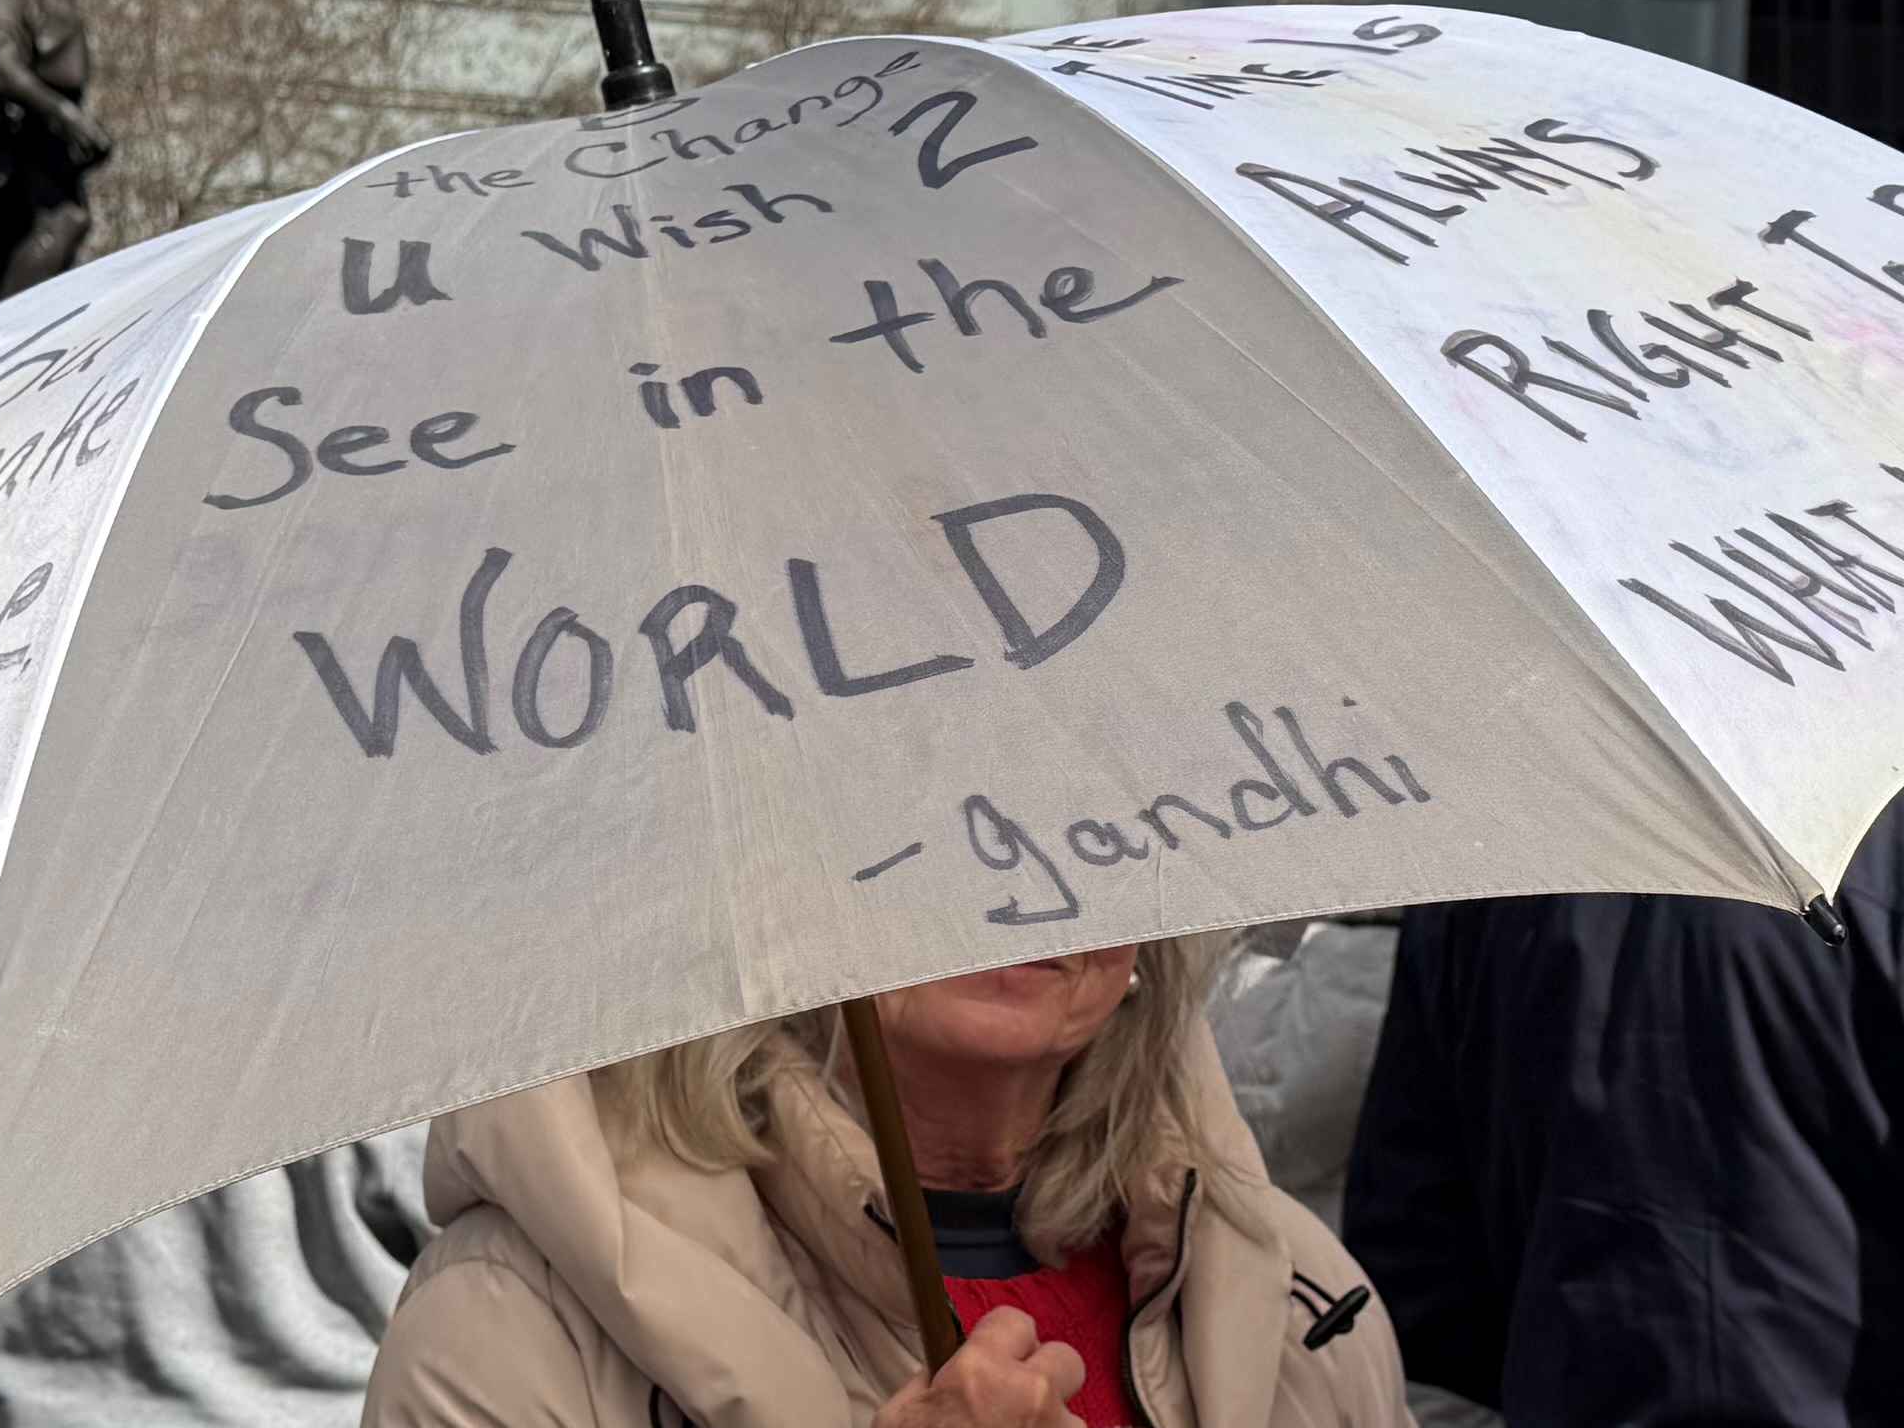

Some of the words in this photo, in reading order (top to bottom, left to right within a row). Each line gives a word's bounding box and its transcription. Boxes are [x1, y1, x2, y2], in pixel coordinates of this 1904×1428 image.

[1052, 60, 1343, 110] TIME
[1248, 16, 1442, 55] IS
[366, 163, 536, 200] the
[888, 91, 1038, 189] 2
[1235, 117, 1662, 266] ALWAYS
[203, 384, 517, 511] See
[627, 363, 765, 429] in
[829, 257, 1186, 374] the
[1439, 278, 1813, 442] RIGHT
[295, 491, 1126, 759] WORLD
